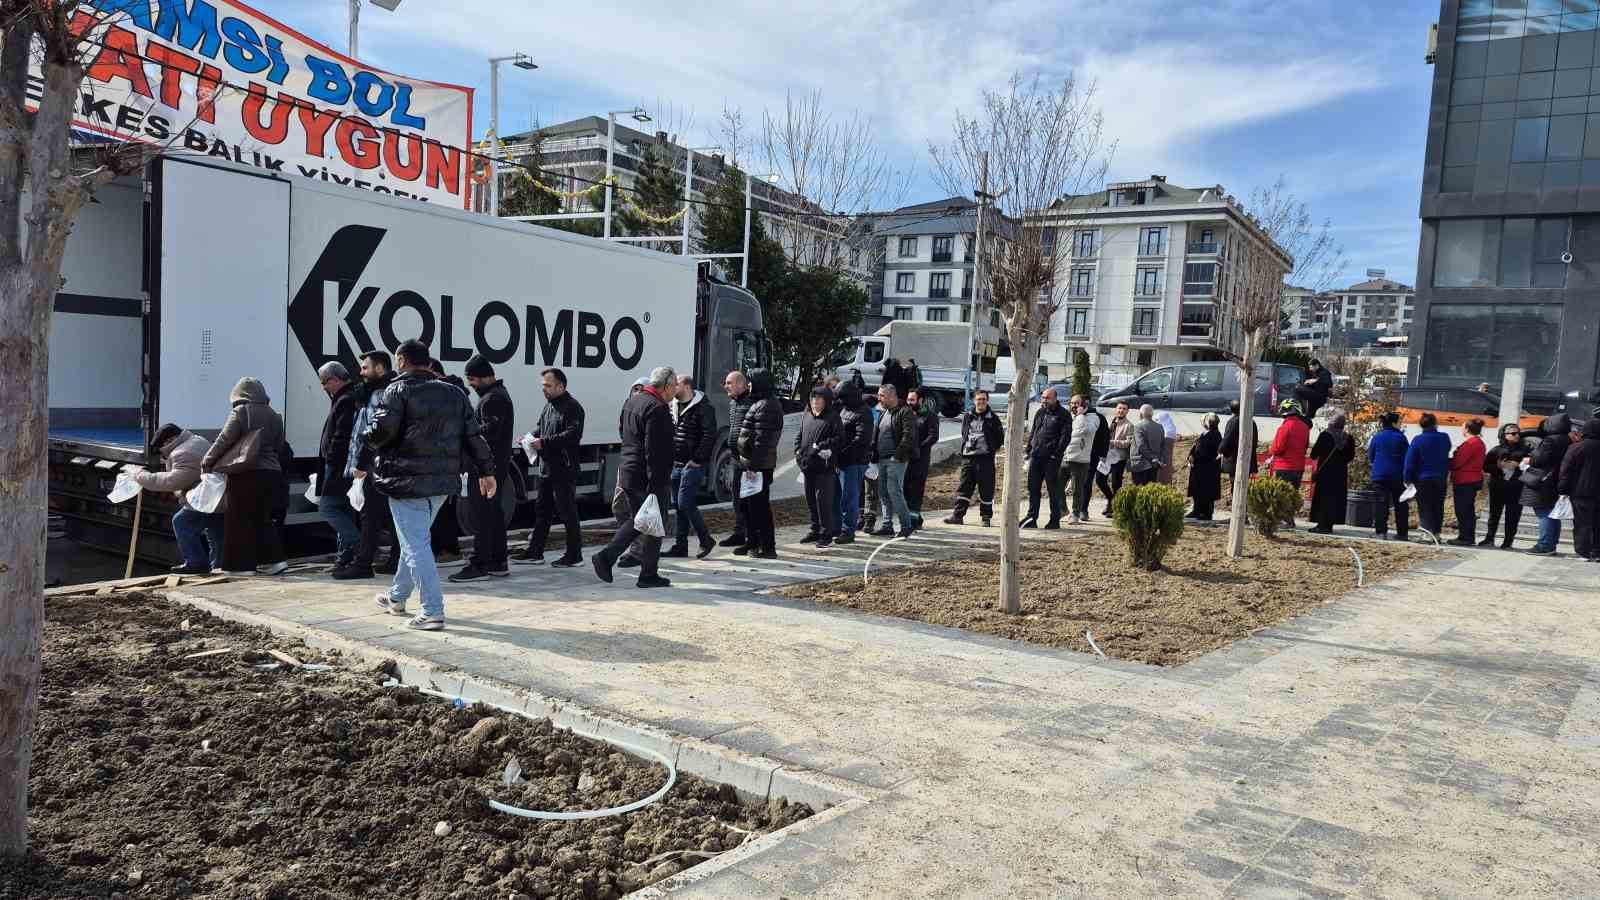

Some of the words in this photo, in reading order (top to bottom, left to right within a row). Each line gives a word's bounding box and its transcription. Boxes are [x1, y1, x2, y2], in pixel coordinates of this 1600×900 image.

[304, 54, 426, 130] BOL
[184, 127, 284, 172] BALIK
[242, 80, 461, 195] UYGUN
[322, 279, 644, 371] KOLOMBO
